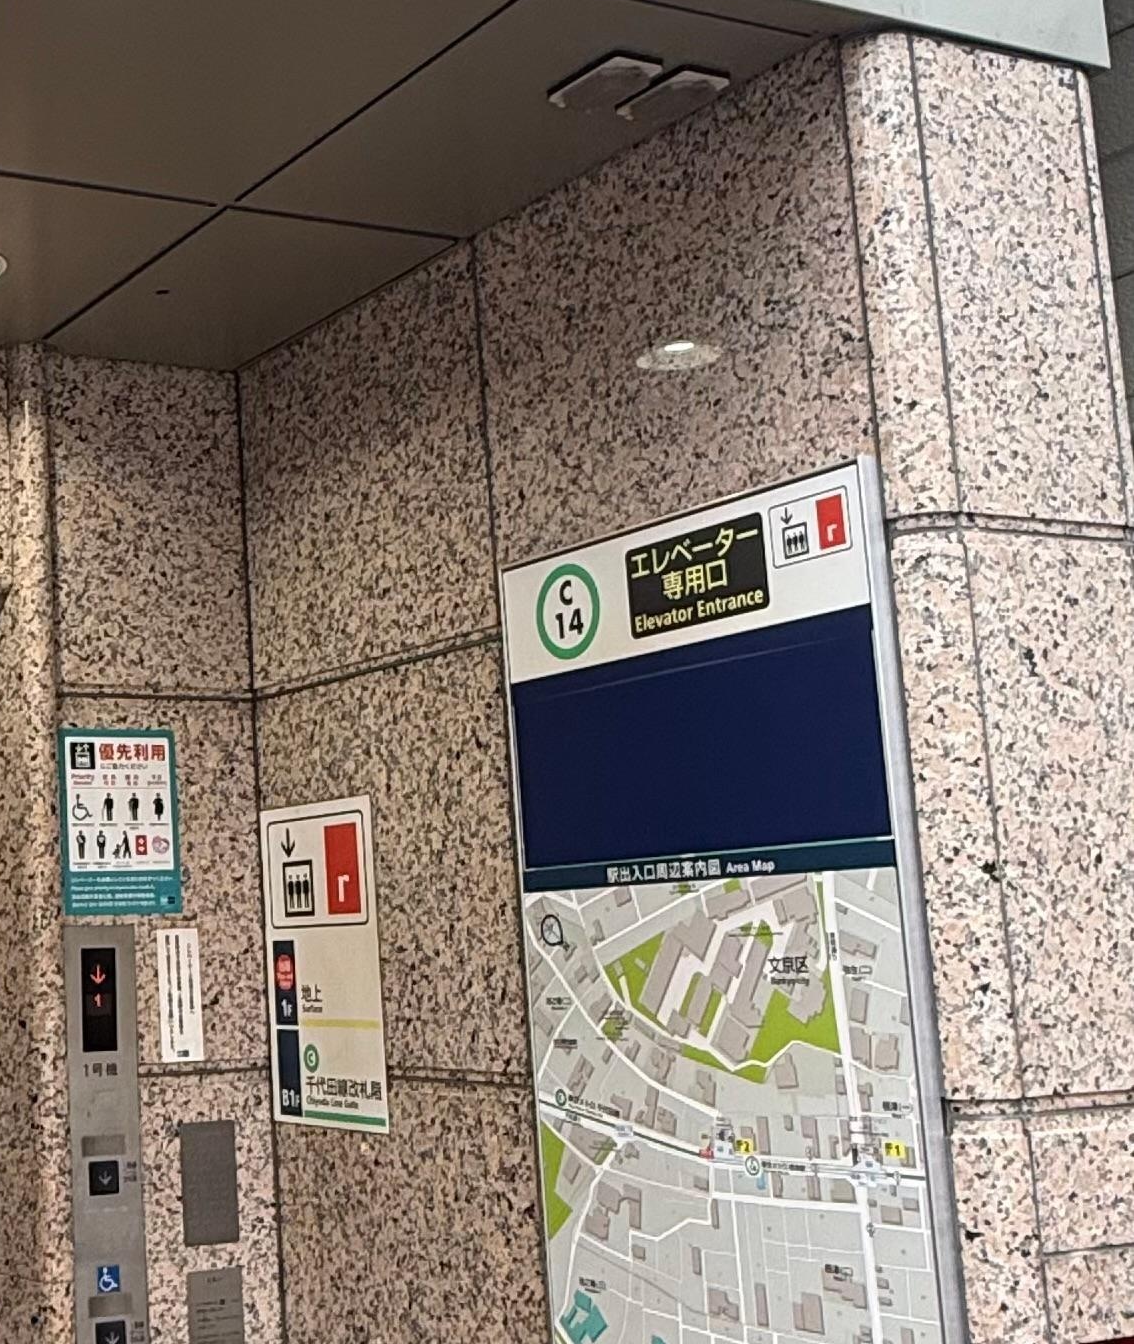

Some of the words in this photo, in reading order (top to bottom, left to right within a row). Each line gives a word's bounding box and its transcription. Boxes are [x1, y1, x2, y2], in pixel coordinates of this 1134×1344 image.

[630, 526, 758, 579] エレベーター
[559, 580, 572, 606] C
[663, 560, 727, 600] 専用口
[554, 608, 584, 639] 14
[634, 606, 694, 633] Elevator
[697, 588, 763, 619] Entrance
[99, 743, 165, 761] 優先利用
[606, 859, 721, 883] 駅出入口周辺案内図
[726, 860, 747, 874] Area
[750, 858, 775, 874] Map
[301, 984, 322, 1002] 地上
[282, 1089, 300, 1107] B1F
